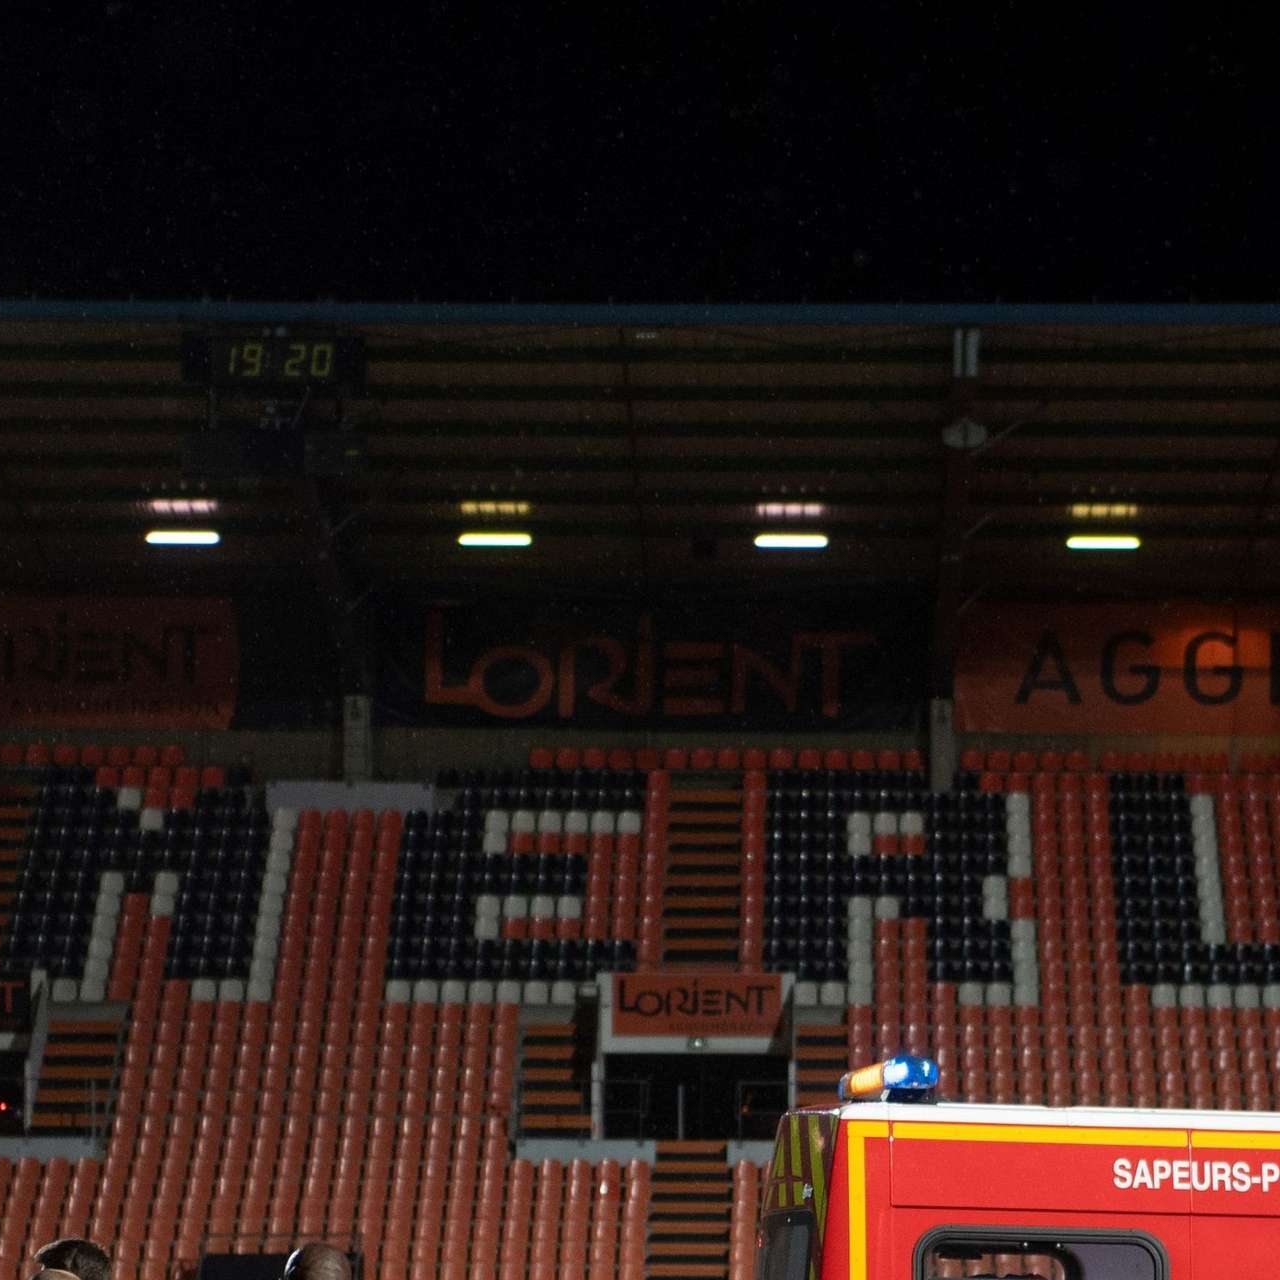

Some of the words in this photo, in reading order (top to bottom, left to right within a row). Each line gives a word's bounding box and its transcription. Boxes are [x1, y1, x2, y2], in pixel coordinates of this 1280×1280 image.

[226, 341, 265, 377] 19
[282, 342, 336, 377] 20
[423, 605, 880, 719] LORIENT
[619, 979, 775, 1016] LORIENT
